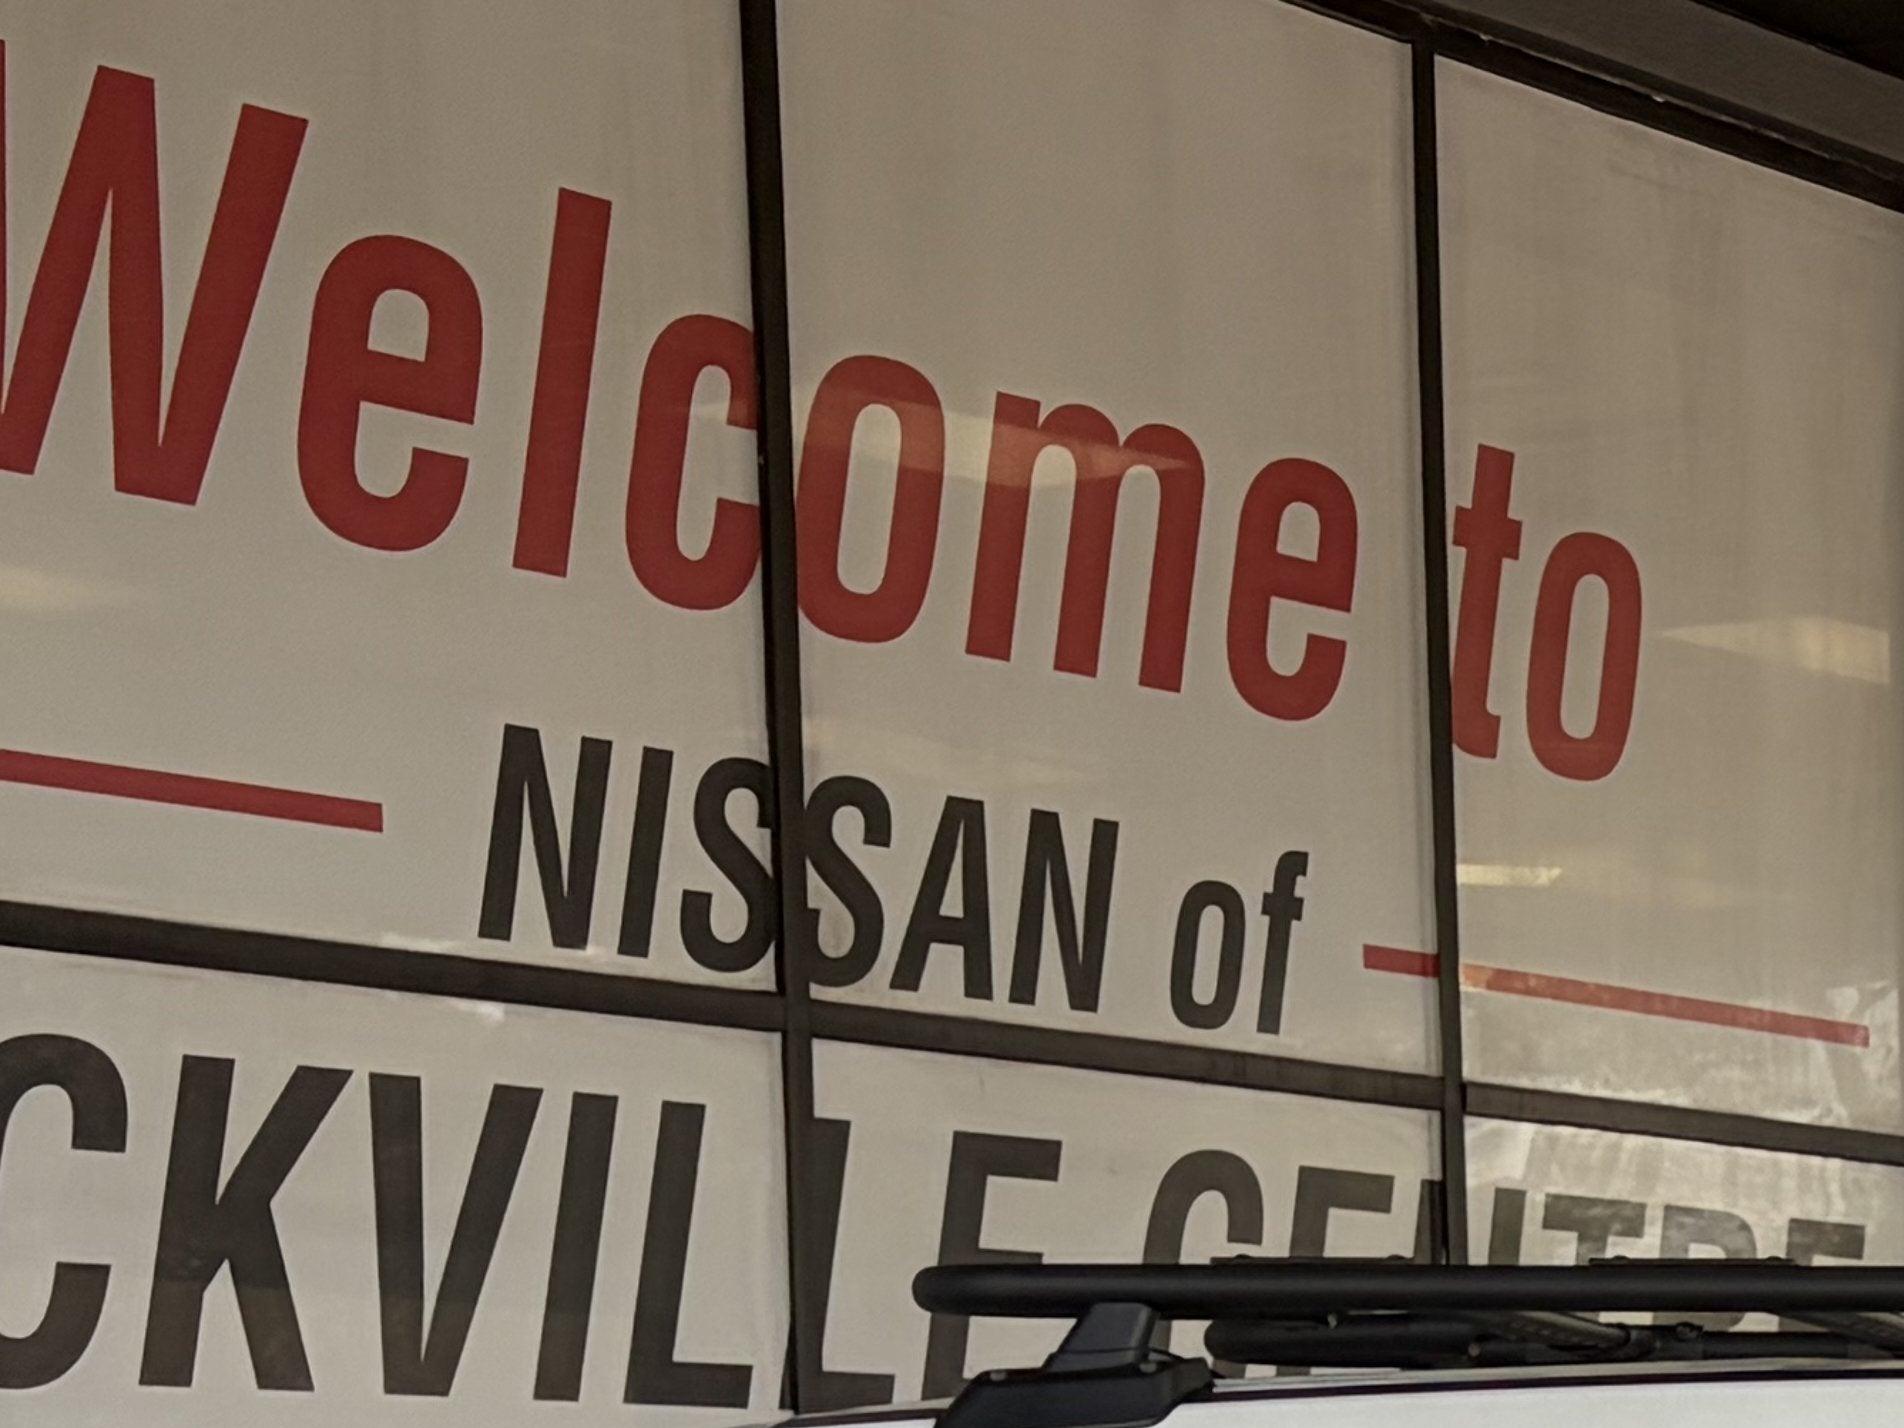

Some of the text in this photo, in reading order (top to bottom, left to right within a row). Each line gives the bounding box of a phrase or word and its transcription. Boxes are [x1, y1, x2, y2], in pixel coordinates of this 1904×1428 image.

[0, 39, 1645, 782] Welcome to
[477, 722, 1310, 1036] NISSAN of
